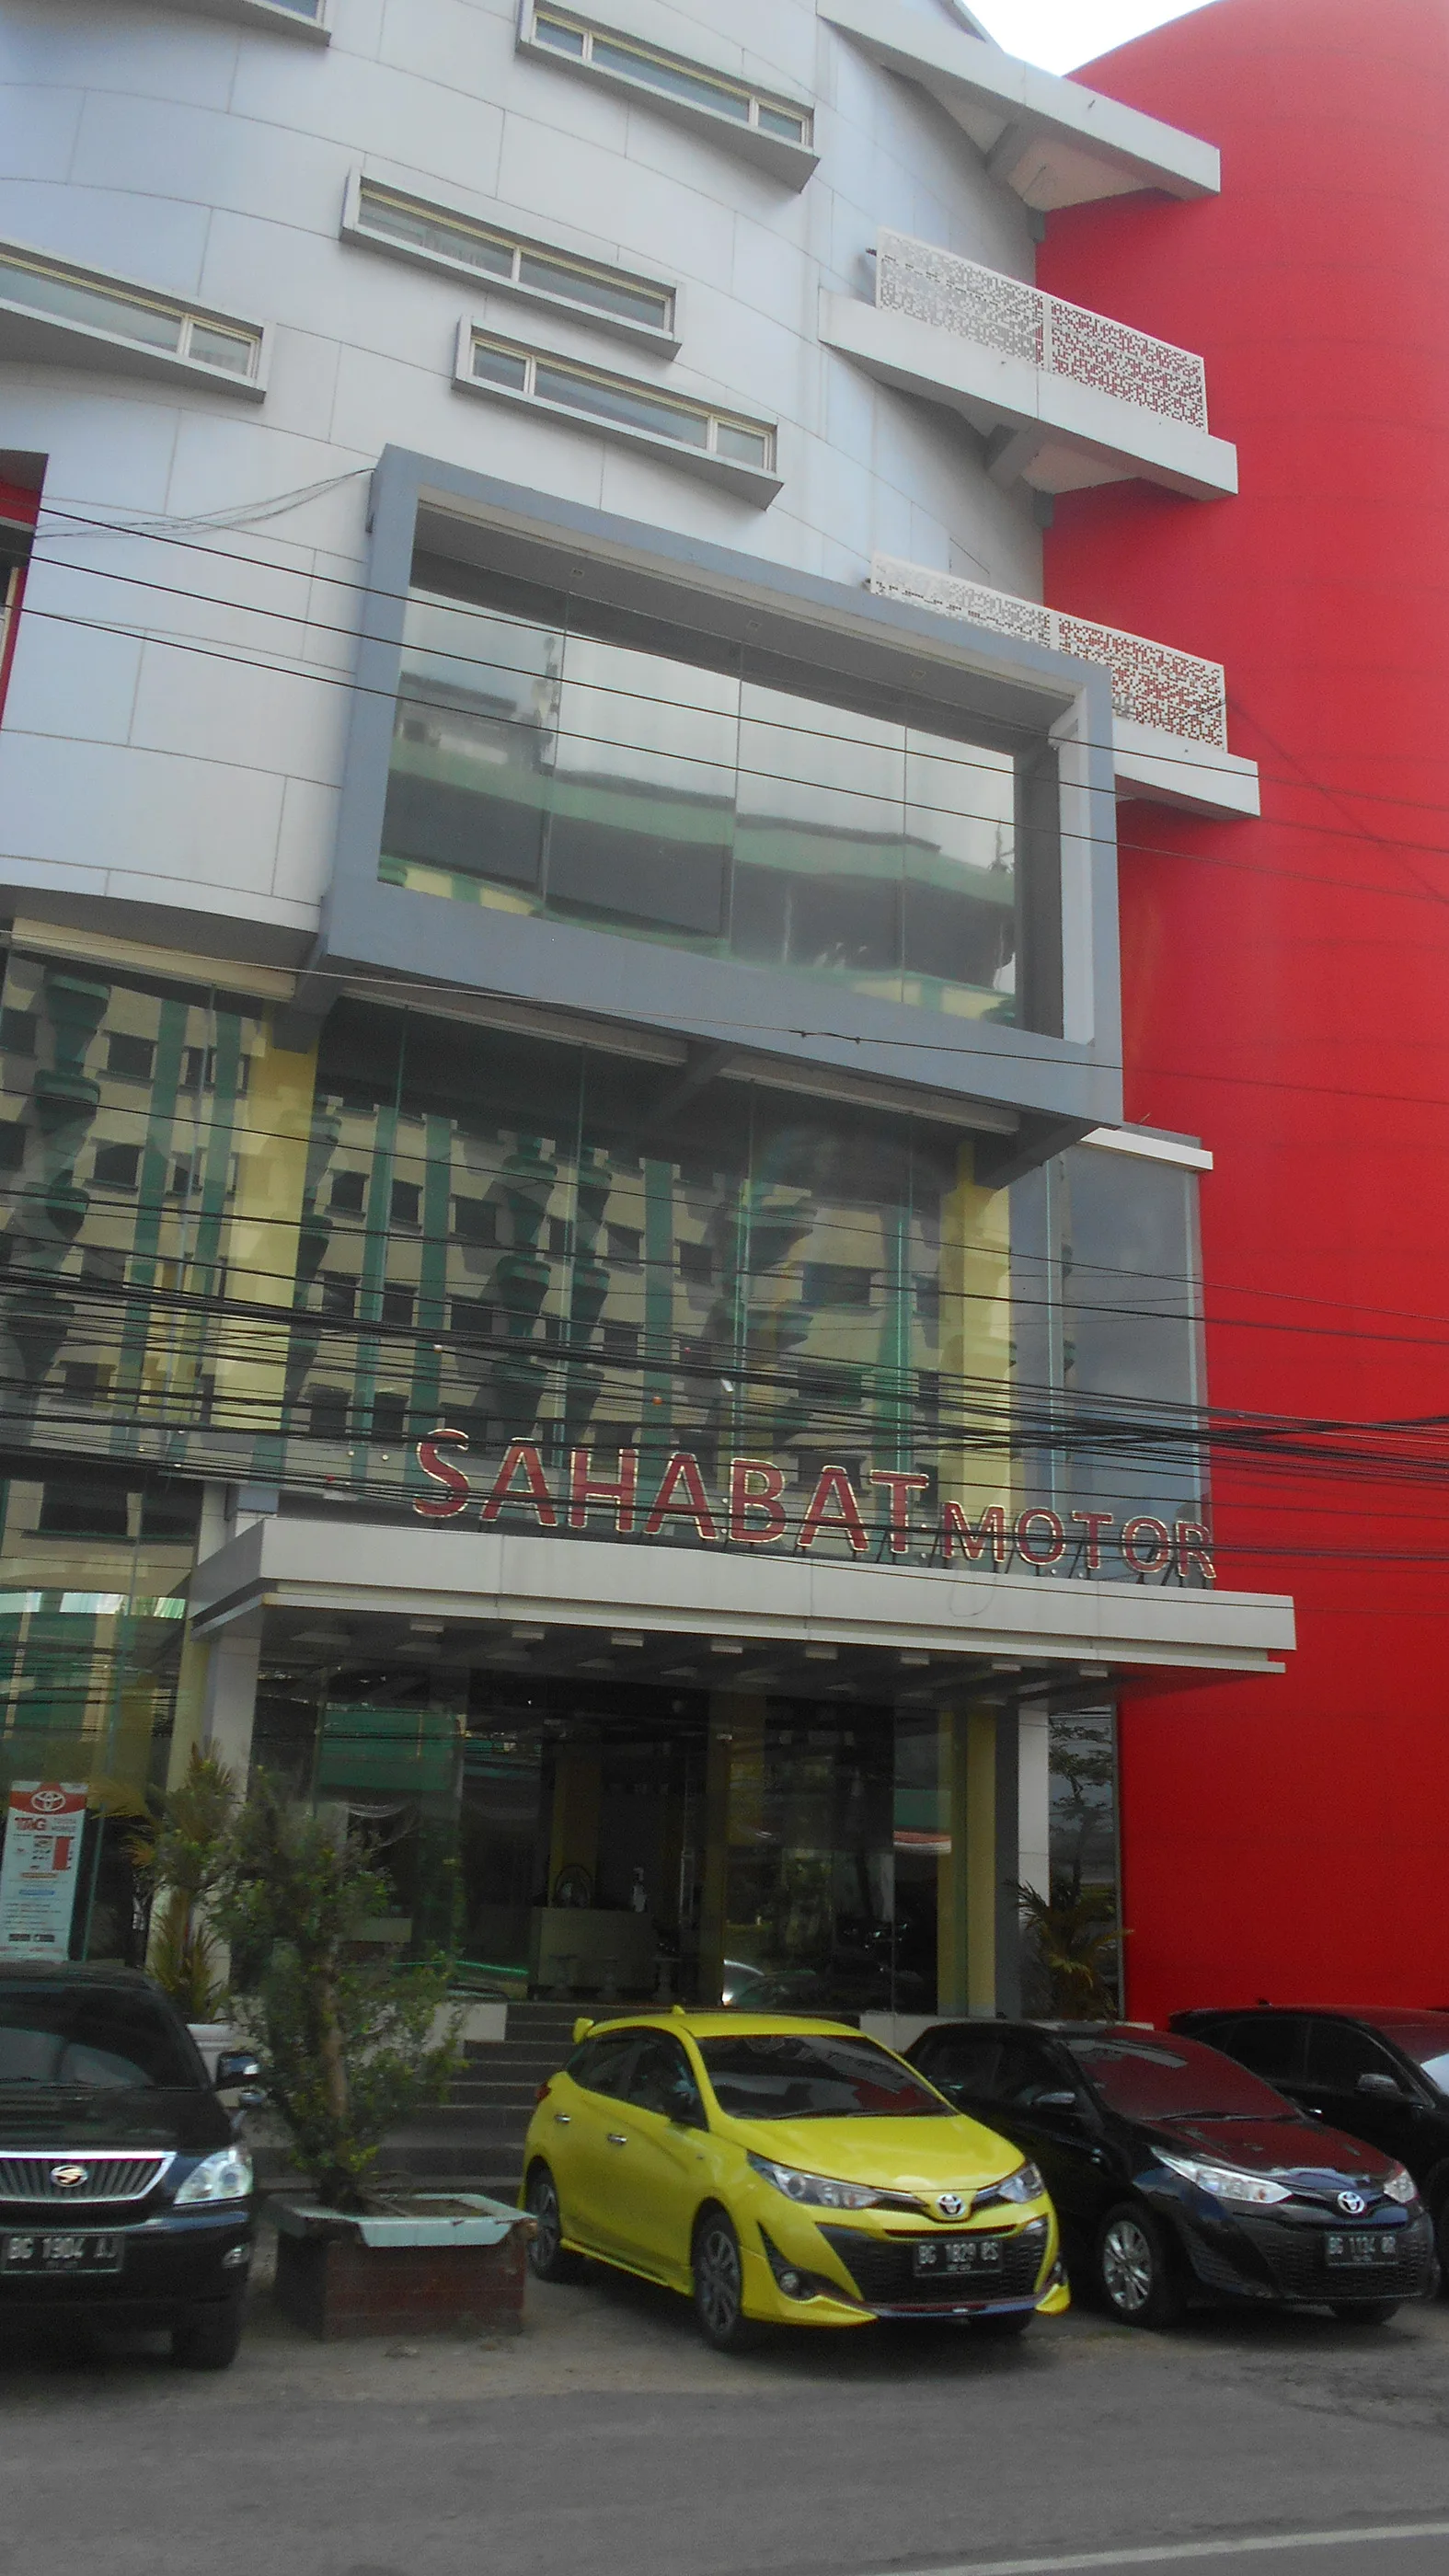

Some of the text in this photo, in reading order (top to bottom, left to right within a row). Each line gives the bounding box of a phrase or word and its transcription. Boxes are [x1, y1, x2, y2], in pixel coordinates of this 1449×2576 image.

[414, 1428, 1217, 1580] SAHABAT MOTOR
[8, 2237, 34, 2260] BG
[918, 2245, 937, 2264] BG
